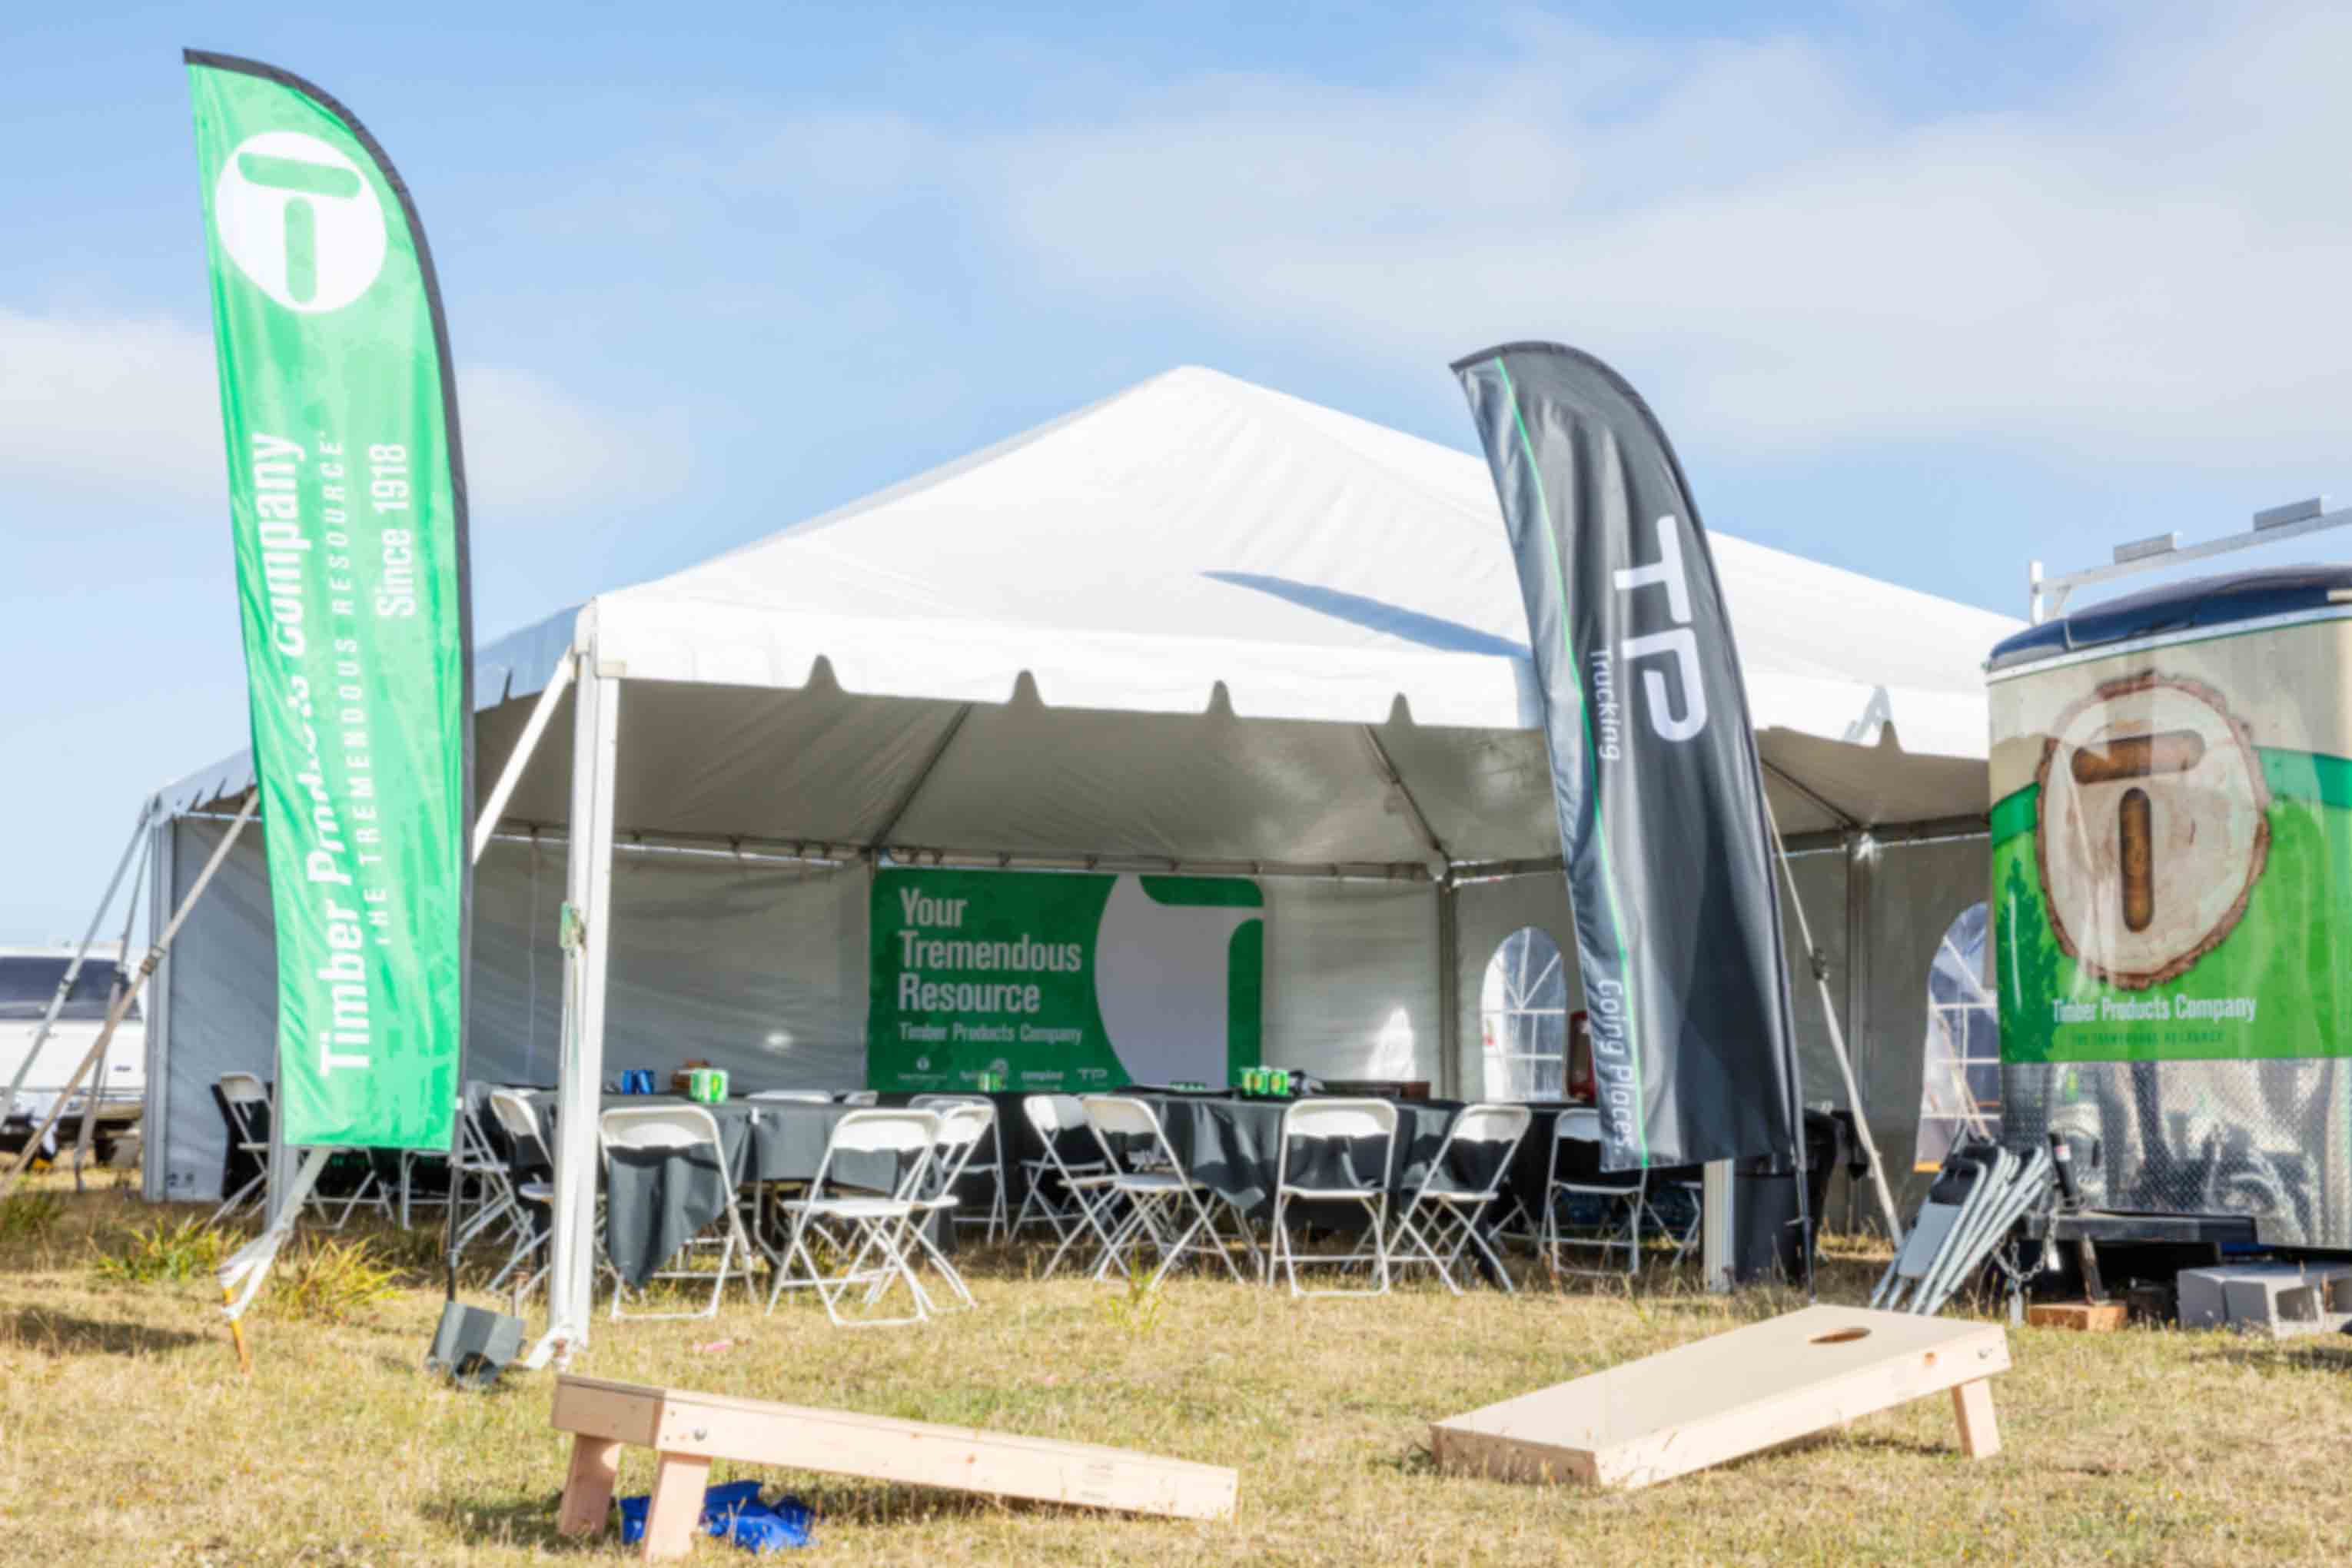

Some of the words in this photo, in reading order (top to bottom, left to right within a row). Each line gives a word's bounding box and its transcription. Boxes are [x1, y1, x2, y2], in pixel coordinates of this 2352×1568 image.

[369, 443, 410, 513] 1918
[251, 432, 311, 656] Company
[376, 528, 417, 618] Since
[1613, 514, 1707, 742] TP
[1590, 648, 1621, 761] Trucking
[334, 639, 382, 866] TREMENDOUS
[899, 887, 968, 928] Your
[316, 898, 370, 1077] Timber
[898, 930, 1082, 972] Tremendous
[898, 972, 1041, 1014] Resource
[1597, 978, 1629, 1055] Going
[2051, 998, 2097, 1023] Timber
[2101, 996, 2170, 1021] Products
[2174, 993, 2257, 1023] Company
[899, 1022, 947, 1041] Timber
[952, 1022, 1015, 1042] Products
[1020, 1023, 1082, 1045] Company
